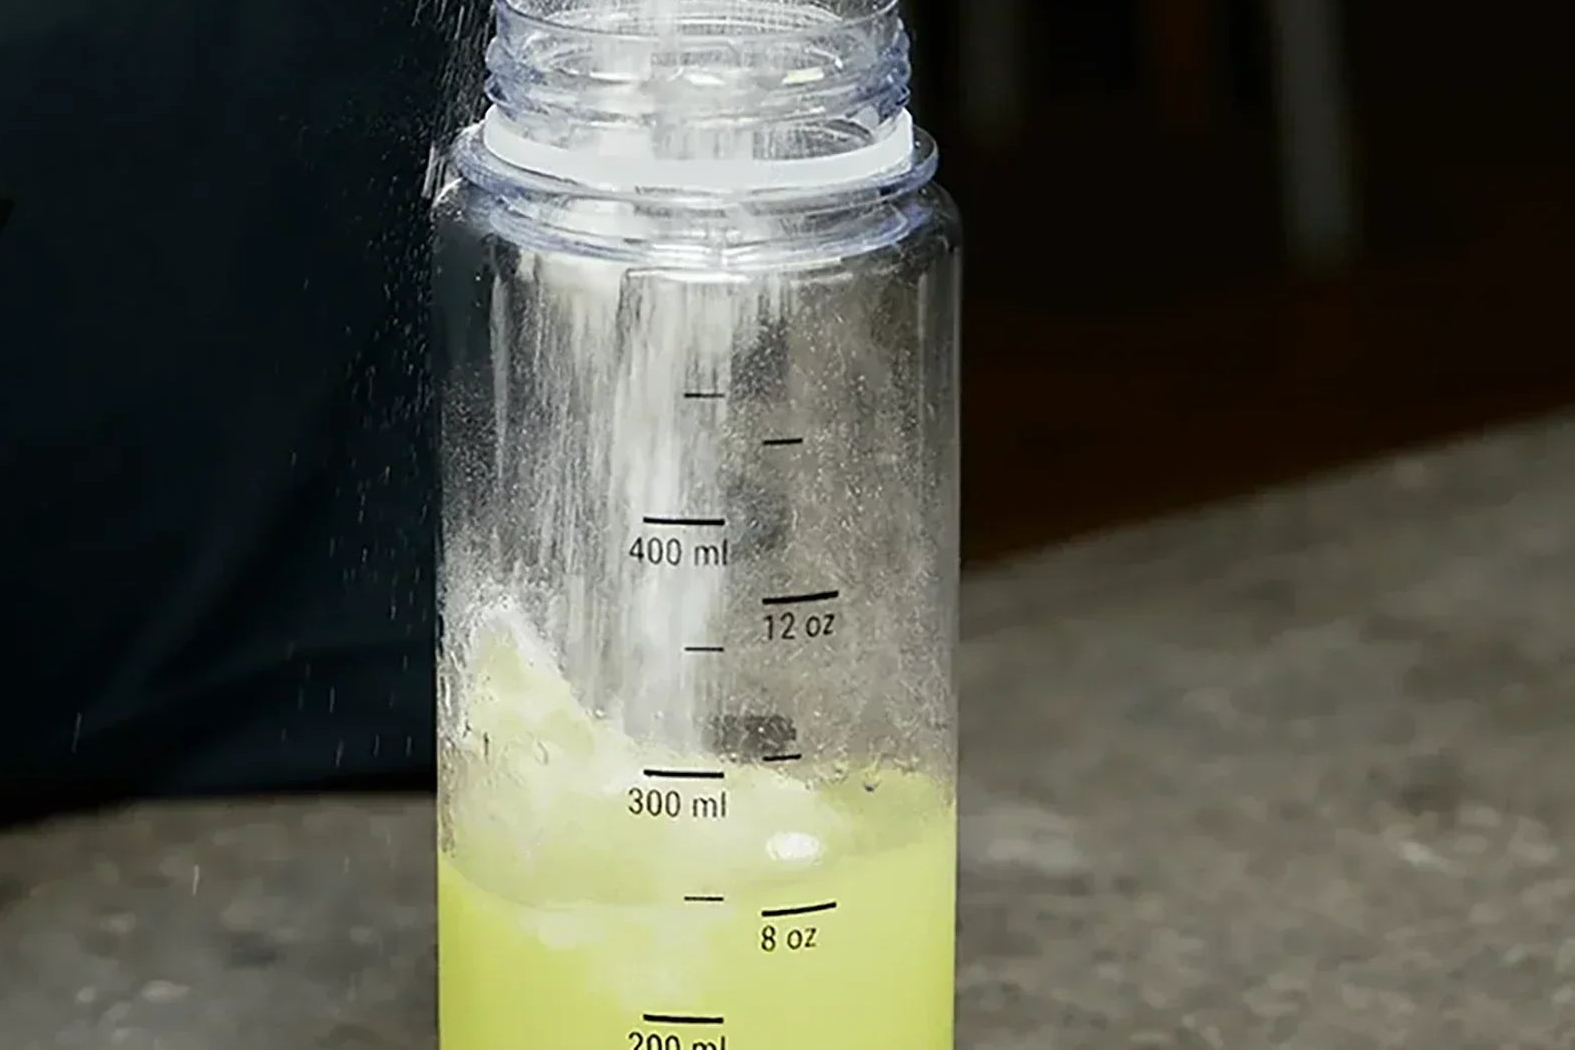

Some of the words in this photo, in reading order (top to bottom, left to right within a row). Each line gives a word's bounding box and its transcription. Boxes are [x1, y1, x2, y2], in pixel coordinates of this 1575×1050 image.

[629, 537, 682, 566] 400
[694, 538, 728, 566] ml
[763, 612, 796, 640] 12
[806, 613, 836, 638] oz
[628, 788, 681, 817] 300
[692, 791, 726, 817] ml
[761, 925, 776, 951] 8
[787, 927, 817, 950] oz
